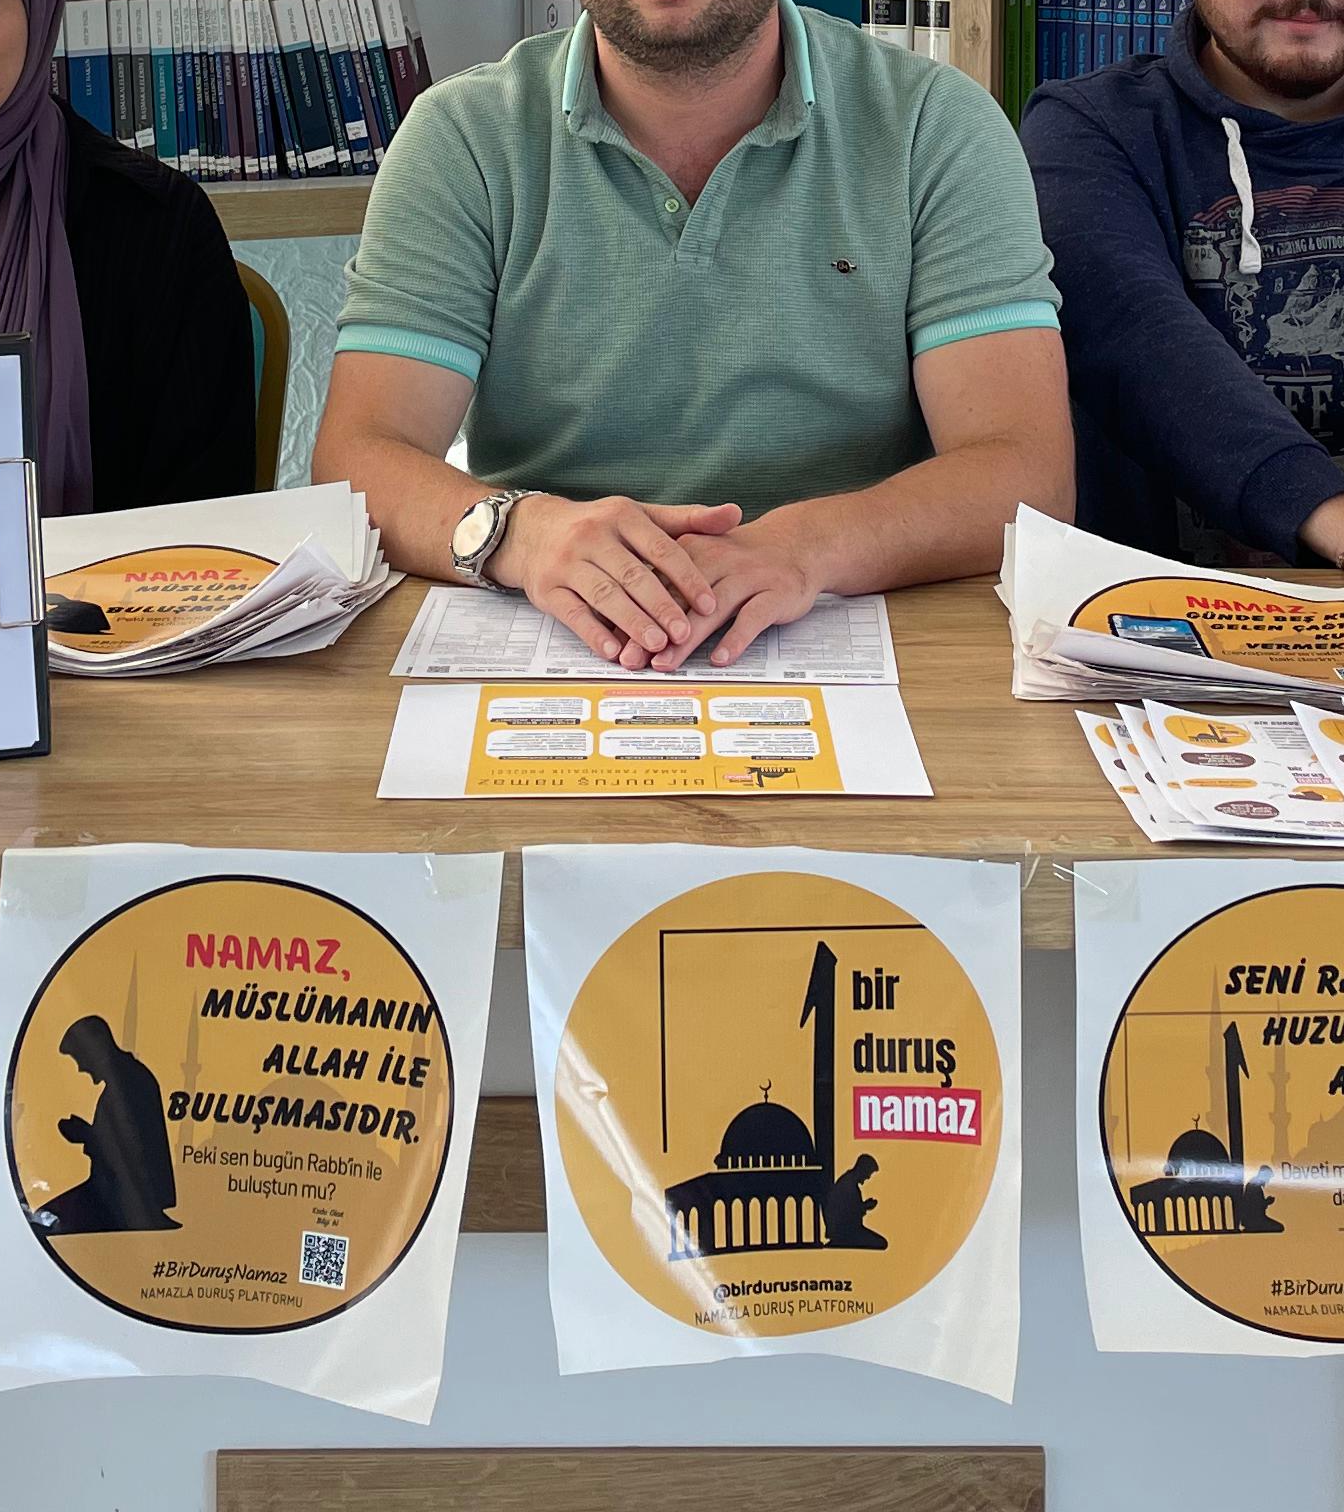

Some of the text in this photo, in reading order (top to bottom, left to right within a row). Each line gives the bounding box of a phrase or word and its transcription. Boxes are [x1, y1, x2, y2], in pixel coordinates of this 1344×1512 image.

[1186, 611, 1264, 622] GÜNDE
[1273, 614, 1315, 623] BEŞ
[1211, 623, 1283, 631] GELEN
[184, 933, 352, 982] NAMAZ,
[852, 967, 900, 1012] bir
[1225, 956, 1308, 997] SENİ
[200, 987, 434, 1035] MÜSLÜMANIN
[262, 1043, 432, 1089] ALLAH İLE
[852, 1031, 958, 1088] duruş
[168, 1090, 422, 1145] BULUŞMASIDIR.
[859, 1092, 978, 1138] namaz
[182, 1145, 217, 1169] Peki
[220, 1151, 250, 1169] sen
[253, 1148, 305, 1178] bugün
[366, 1159, 383, 1181] ile
[1280, 1162, 1329, 1181] Daveti
[228, 1173, 336, 1202] buluştun mu?
[152, 1260, 288, 1286] #BirDuruşNamaz
[140, 1286, 304, 1308] NAMAZLA DURUŞ PLATFORMU
[712, 1276, 854, 1304] @birdurusnamaz
[694, 1298, 875, 1326] NAMAZLA DURUŞ PLATFORMU
[1263, 1303, 1318, 1318] NAMAZLA
